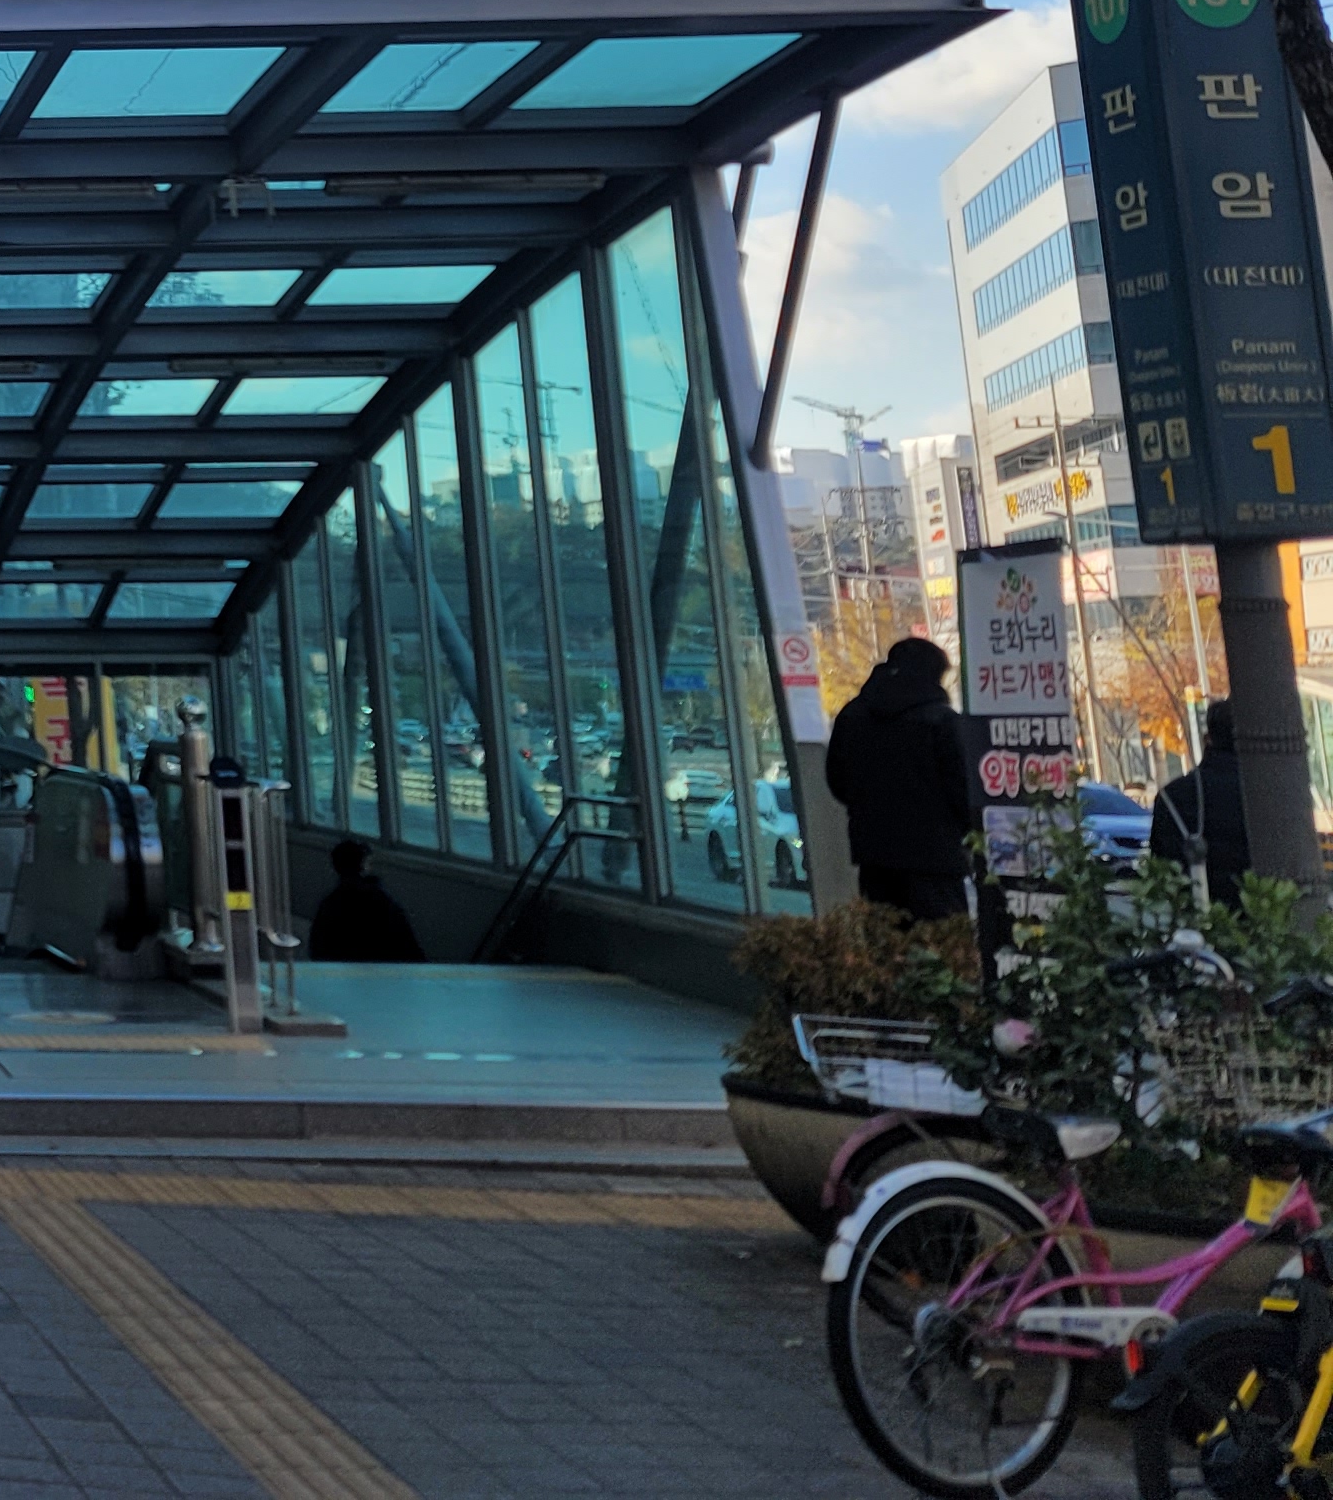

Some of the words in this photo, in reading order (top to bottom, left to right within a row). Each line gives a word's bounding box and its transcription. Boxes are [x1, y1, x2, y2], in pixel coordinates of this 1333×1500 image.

[1203, 265, 1305, 287] (대전대)
[1232, 338, 1296, 354] Panam
[1252, 425, 1296, 494] 1
[1160, 464, 1176, 506] 1
[988, 613, 1059, 656] 문화누리
